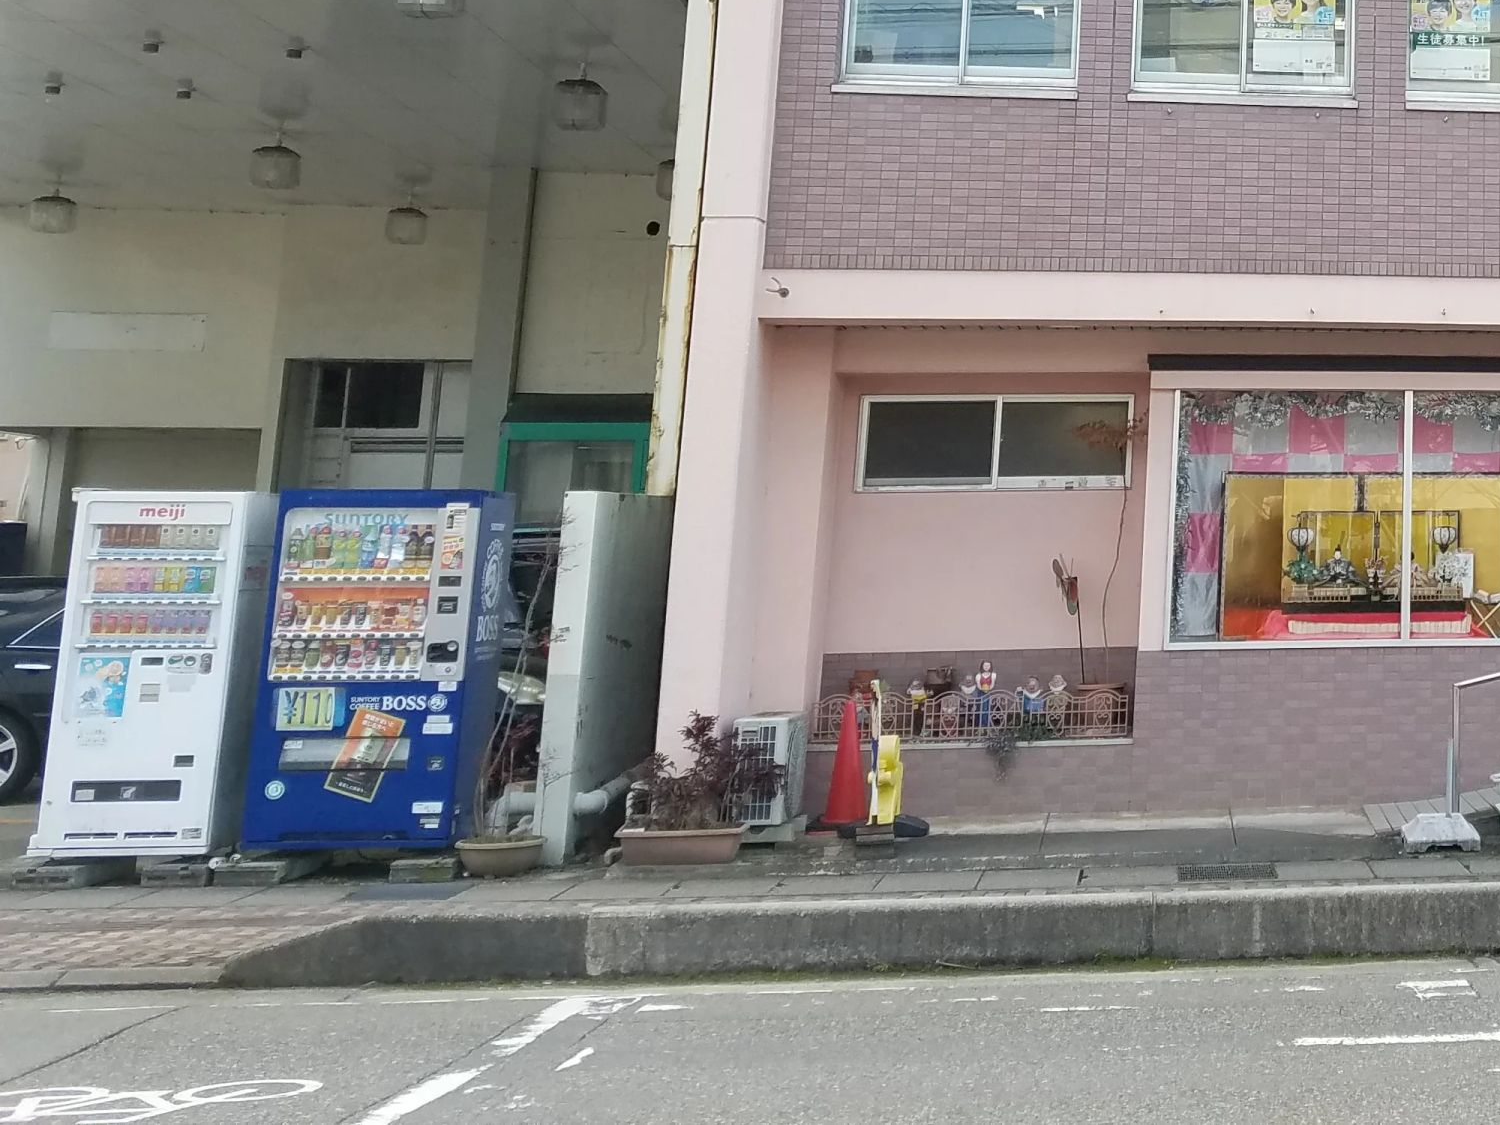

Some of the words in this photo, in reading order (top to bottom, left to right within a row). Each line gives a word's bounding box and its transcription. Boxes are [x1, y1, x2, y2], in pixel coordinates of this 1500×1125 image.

[1417, 33, 1485, 47] 生徒募集中!
[139, 504, 186, 521] meiji
[476, 615, 500, 642] BOSS
[283, 688, 334, 725] ¥110
[381, 695, 427, 711] BOSS
